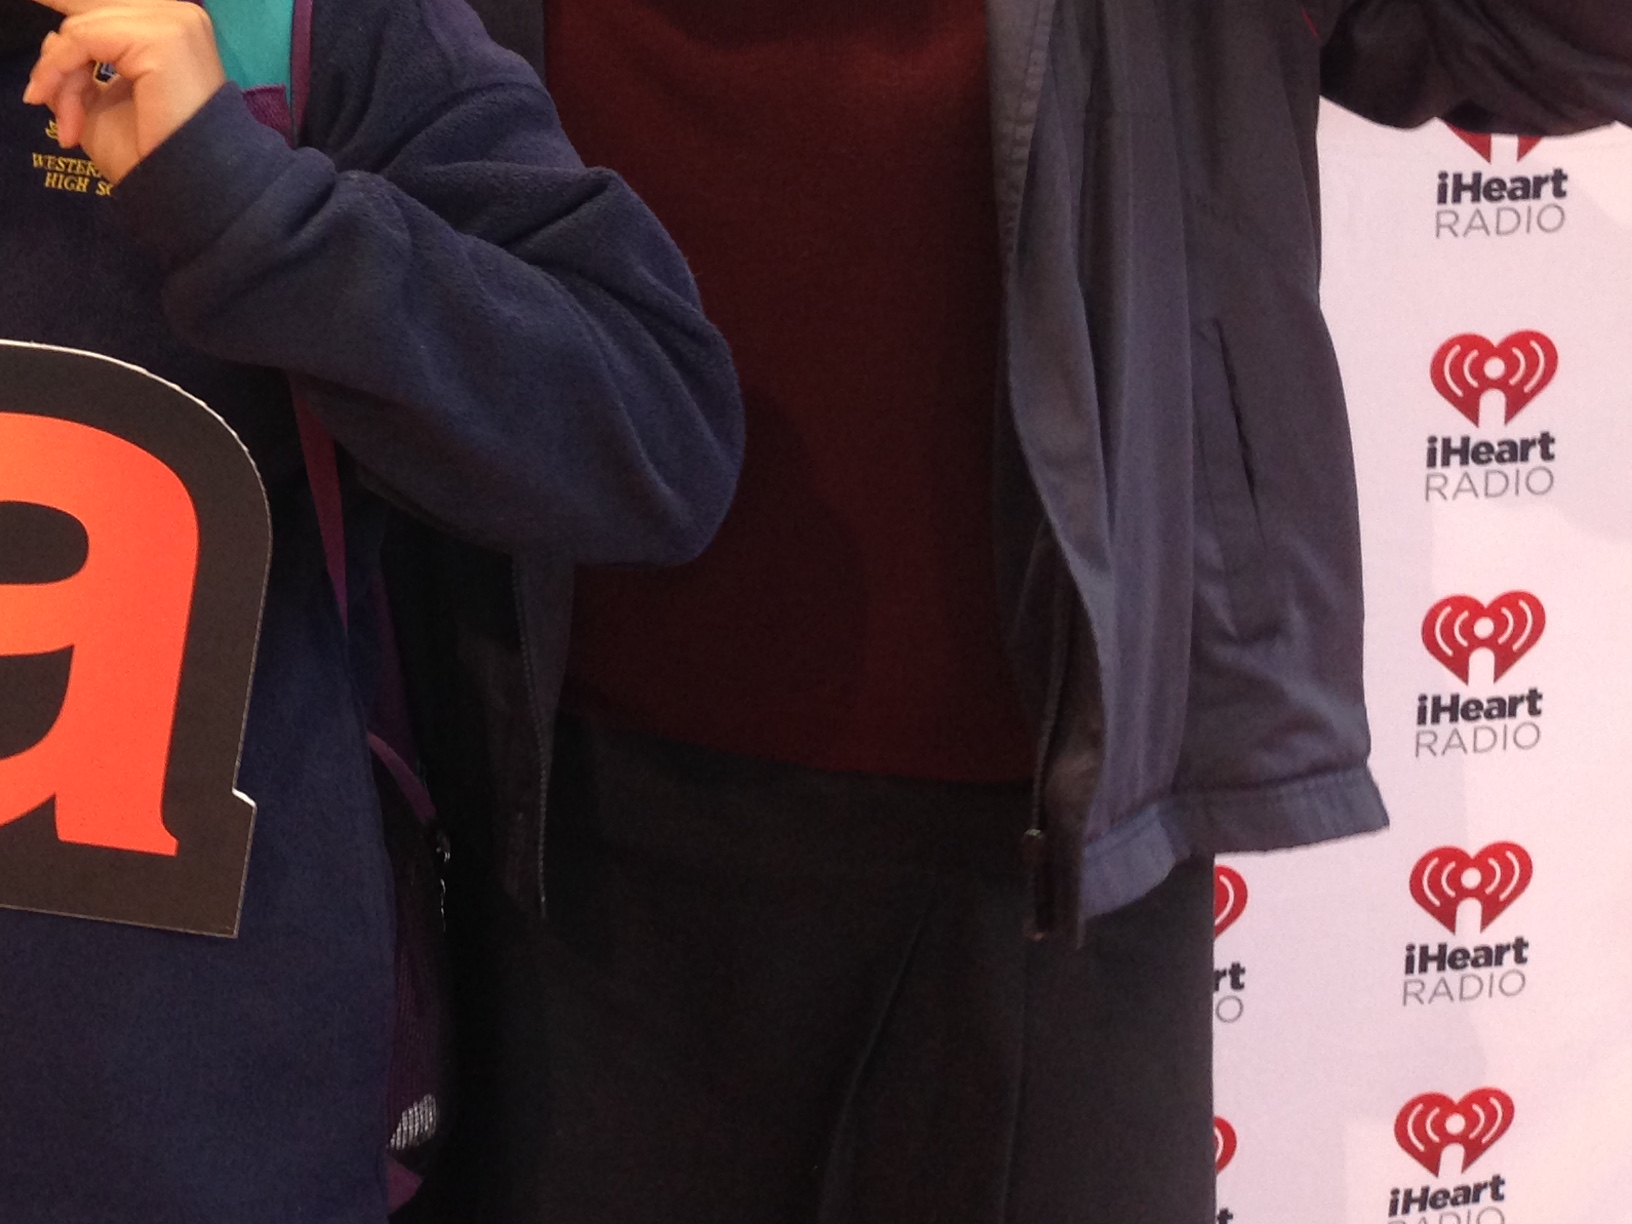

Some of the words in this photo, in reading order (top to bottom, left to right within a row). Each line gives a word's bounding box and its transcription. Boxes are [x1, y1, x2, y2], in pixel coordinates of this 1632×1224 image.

[1437, 168, 1570, 207] iHeart
[1436, 204, 1567, 240] RADIO
[1426, 431, 1556, 469] iHeart
[1424, 467, 1555, 502] RADIO
[1416, 687, 1543, 725] iHeart
[1414, 722, 1542, 758] RADIO
[1404, 937, 1529, 975] iHeart
[1402, 969, 1527, 1007] RADIO
[1388, 1174, 1506, 1218] iHeart
